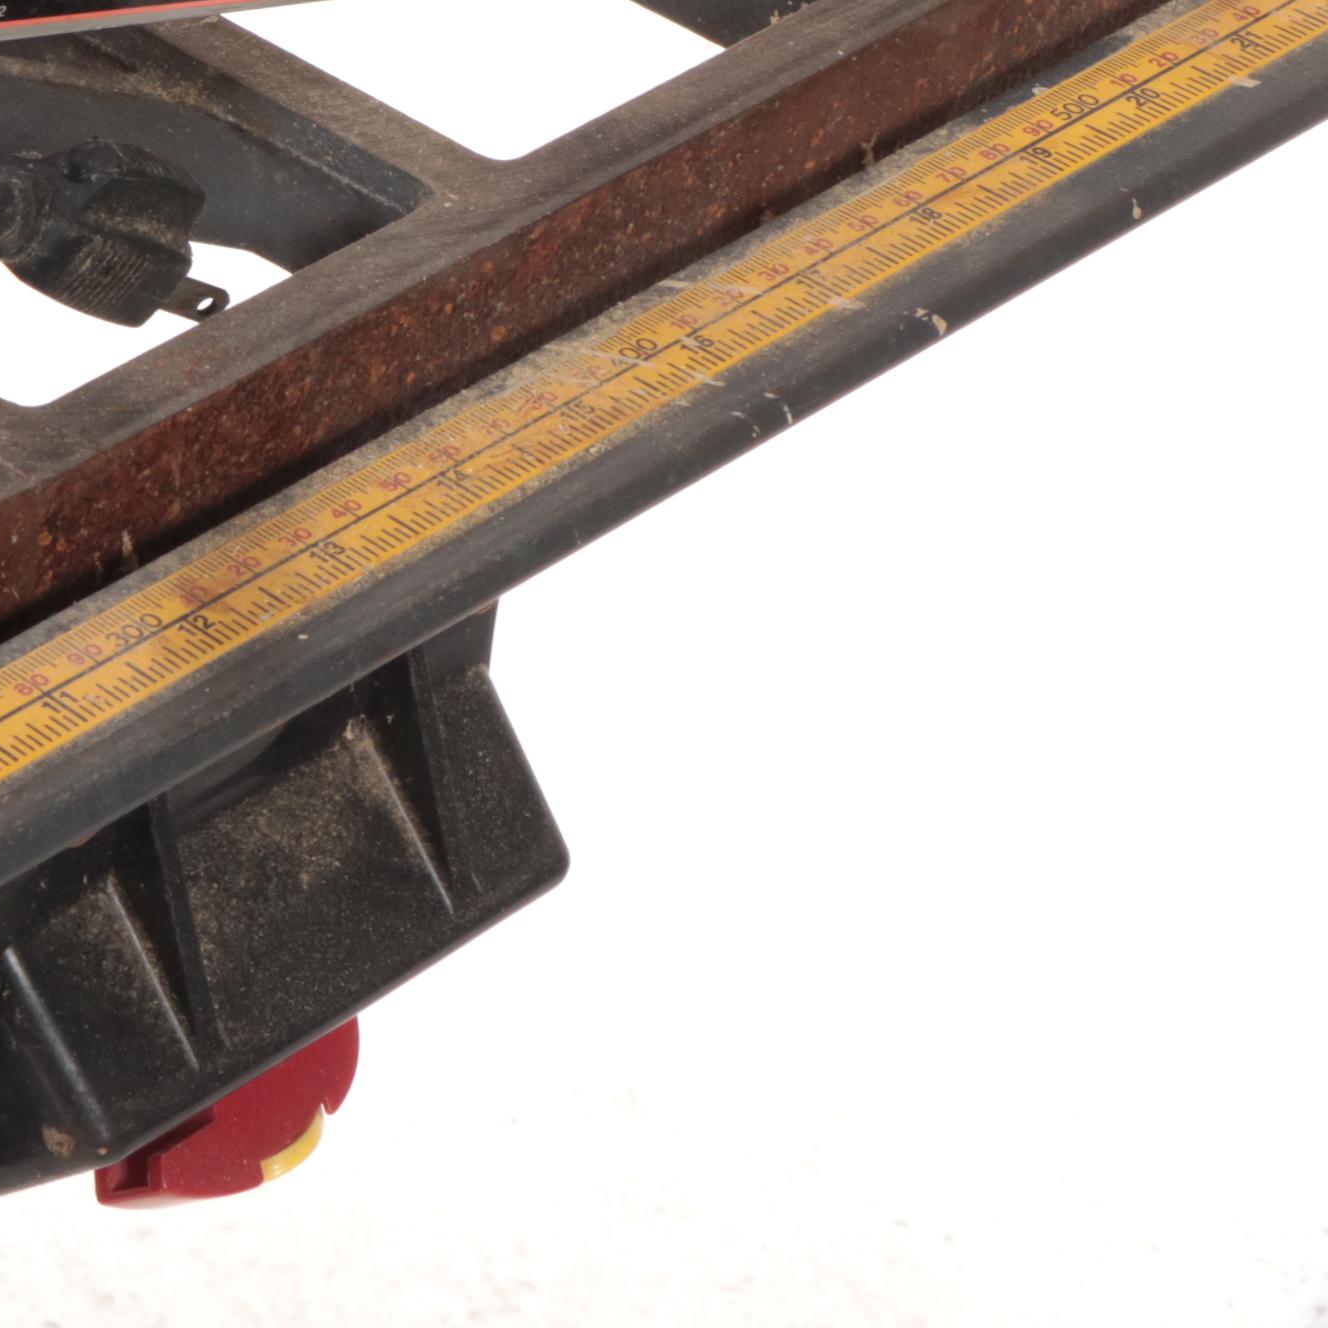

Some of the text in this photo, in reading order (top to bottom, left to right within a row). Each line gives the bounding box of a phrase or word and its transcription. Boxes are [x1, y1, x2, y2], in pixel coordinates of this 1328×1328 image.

[12, 671, 50, 697] 80
[65, 642, 103, 667] 90
[105, 611, 164, 649] 300
[277, 526, 313, 549] 30
[331, 497, 364, 521] 40
[892, 188, 924, 209] 60
[935, 164, 968, 186] 70
[978, 141, 1011, 163] 80
[1021, 118, 1055, 139] 90
[1049, 93, 1100, 122] 500
[1108, 72, 1140, 90] 10
[1147, 50, 1180, 69] 20
[1231, 4, 1263, 23] 40
[177, 614, 216, 639] 12
[309, 540, 349, 565] 13
[558, 399, 597, 423] 15
[680, 333, 716, 356] 16
[907, 205, 944, 228] 18
[1019, 145, 1054, 168] 19
[1125, 86, 1162, 108] 20
[1228, 29, 1265, 51] 21
